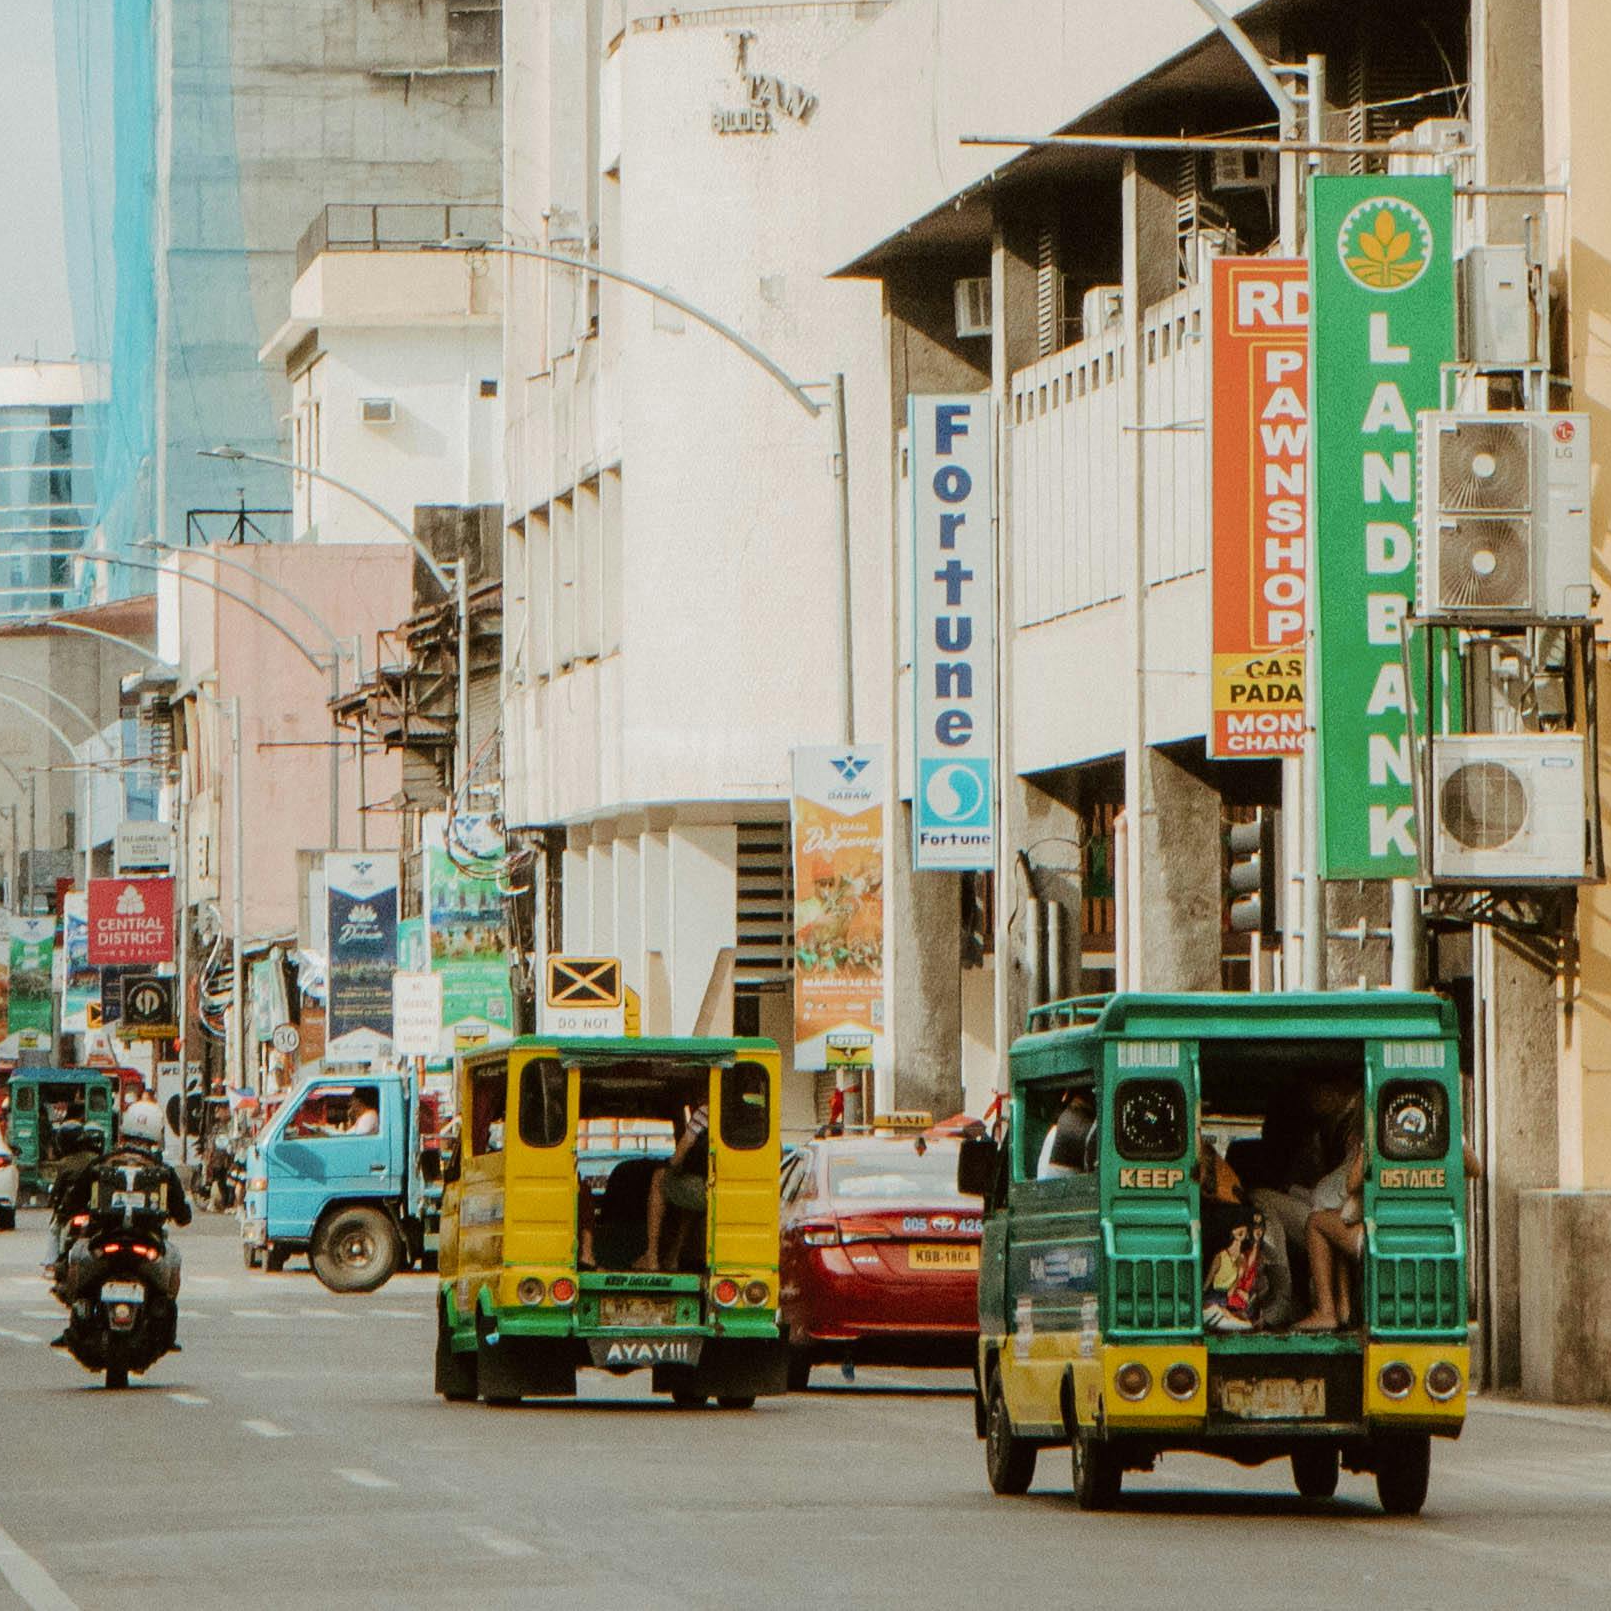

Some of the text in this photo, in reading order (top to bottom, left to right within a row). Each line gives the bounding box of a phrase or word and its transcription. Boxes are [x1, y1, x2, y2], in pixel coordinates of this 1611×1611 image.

[1237, 280, 1308, 326] RD
[1555, 448, 1573, 459] LG
[1262, 350, 1306, 643] PAWNSHOP
[932, 404, 974, 747] Fortune
[1361, 313, 1417, 856] LANDBANK
[920, 832, 991, 846] Fortune
[97, 918, 164, 931] CENTRAL
[97, 931, 164, 946] DISTRICT
[558, 1017, 609, 1029] DO NOT
[277, 1031, 297, 1048] 30
[1119, 1167, 1446, 1189] KEEP DISTANCE
[903, 1217, 927, 1232] 005
